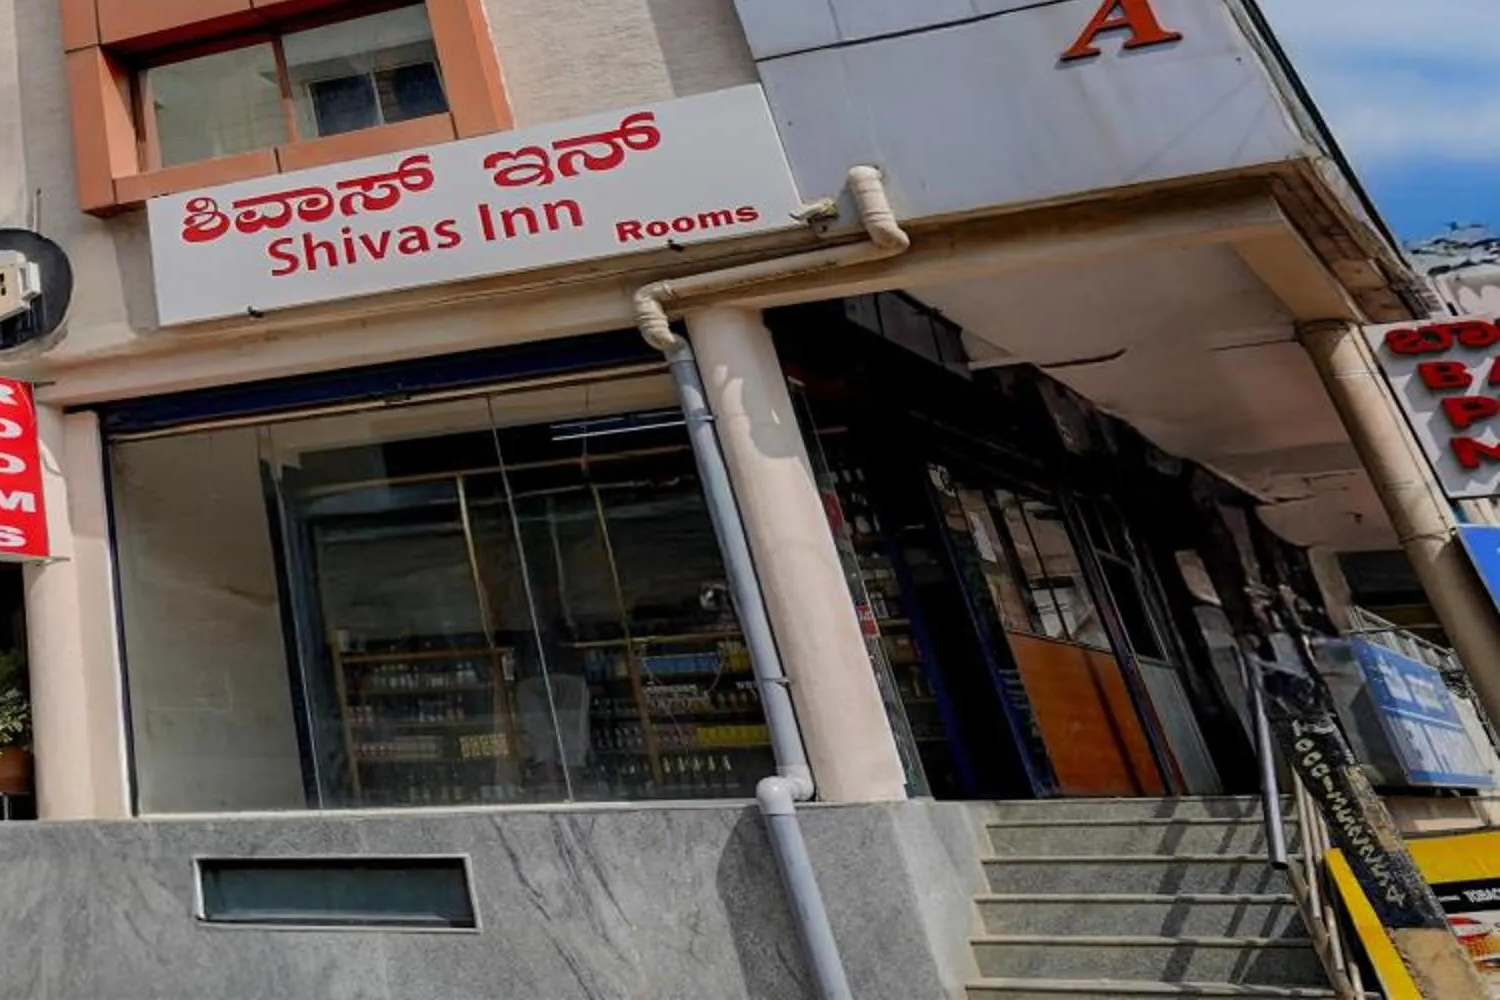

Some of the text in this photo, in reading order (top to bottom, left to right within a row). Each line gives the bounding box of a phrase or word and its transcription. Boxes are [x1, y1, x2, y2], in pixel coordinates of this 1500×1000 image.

[182, 111, 662, 243] ಶಿವಾಸ್ ಇನ್
[267, 198, 760, 277] Shivas Inn Rooms
